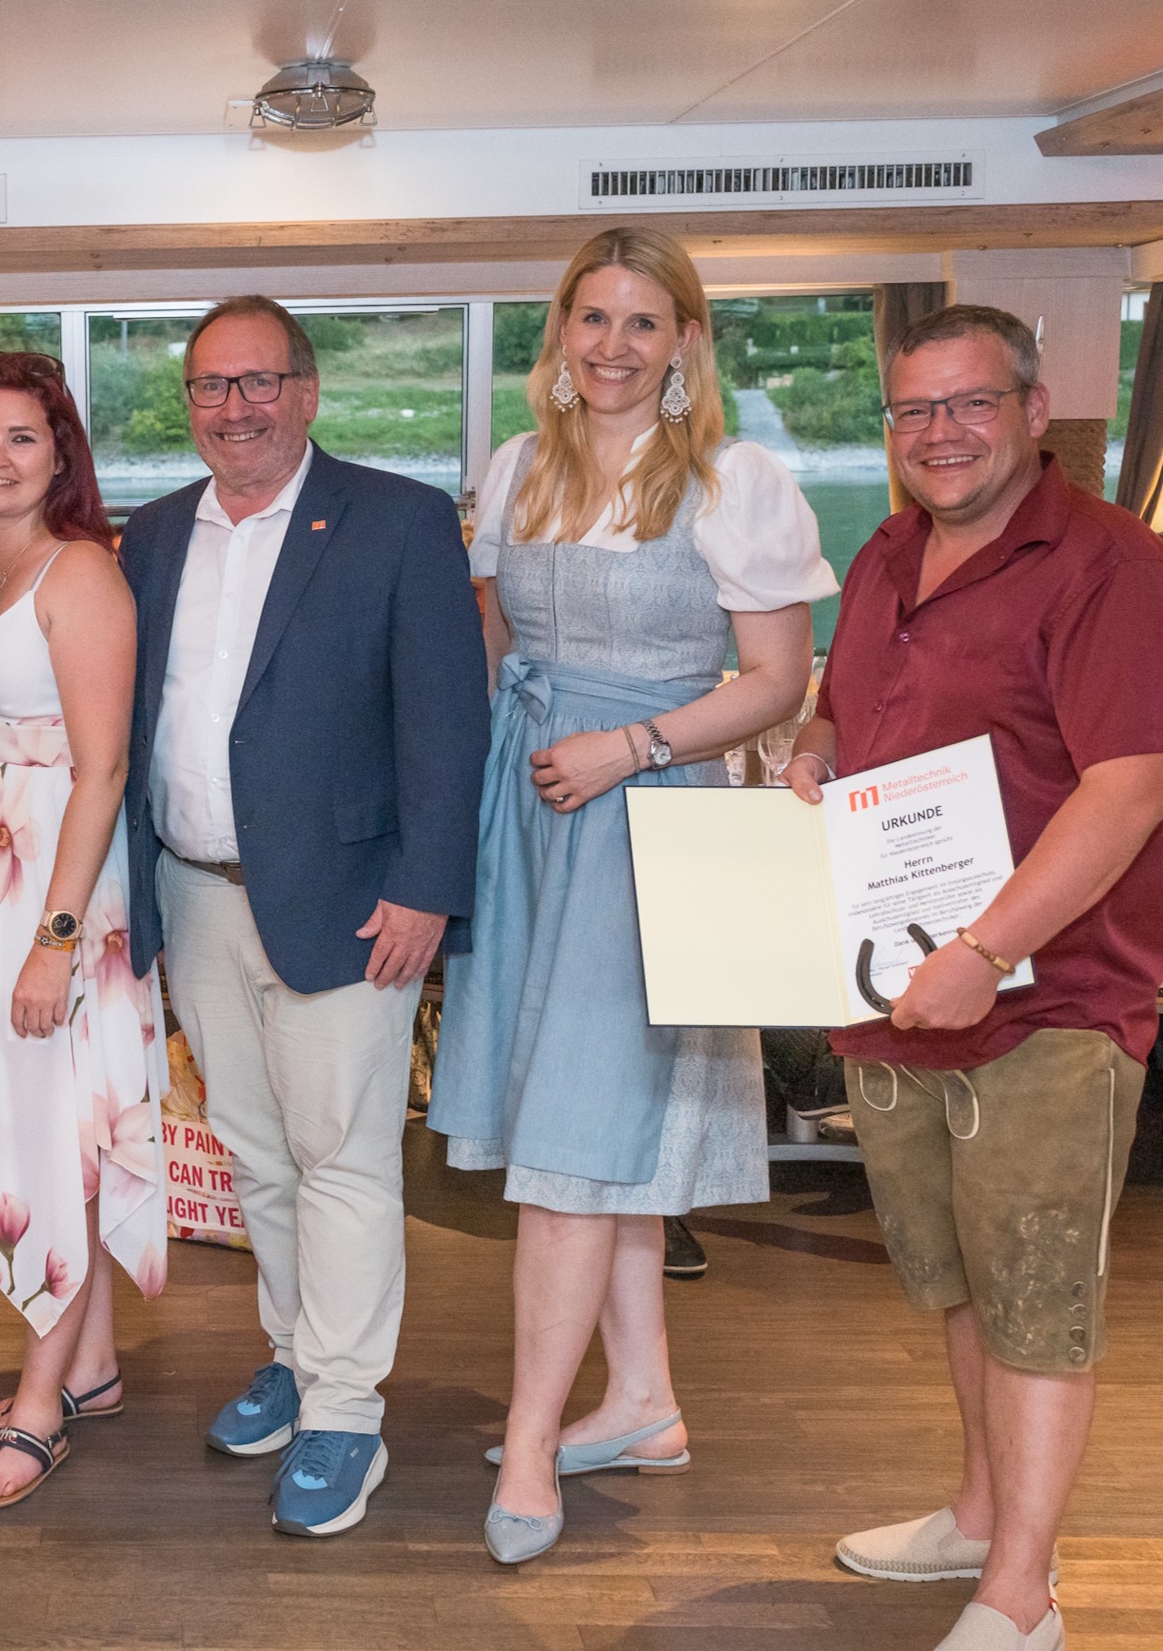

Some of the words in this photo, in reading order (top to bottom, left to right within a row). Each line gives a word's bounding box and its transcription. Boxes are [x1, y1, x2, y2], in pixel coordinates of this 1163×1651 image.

[882, 766, 951, 792] Metalltechnik
[883, 772, 968, 802] Niederösterreich
[881, 805, 943, 831] URKUNDE
[867, 874, 909, 891] Matthias
[911, 858, 974, 879] Kittenberger
[904, 856, 934, 869] Herrn
[185, 1128, 233, 1156] PAIN
[169, 1161, 203, 1188] CAN
[167, 1195, 209, 1224] IGHT
[215, 1205, 245, 1228] YE
